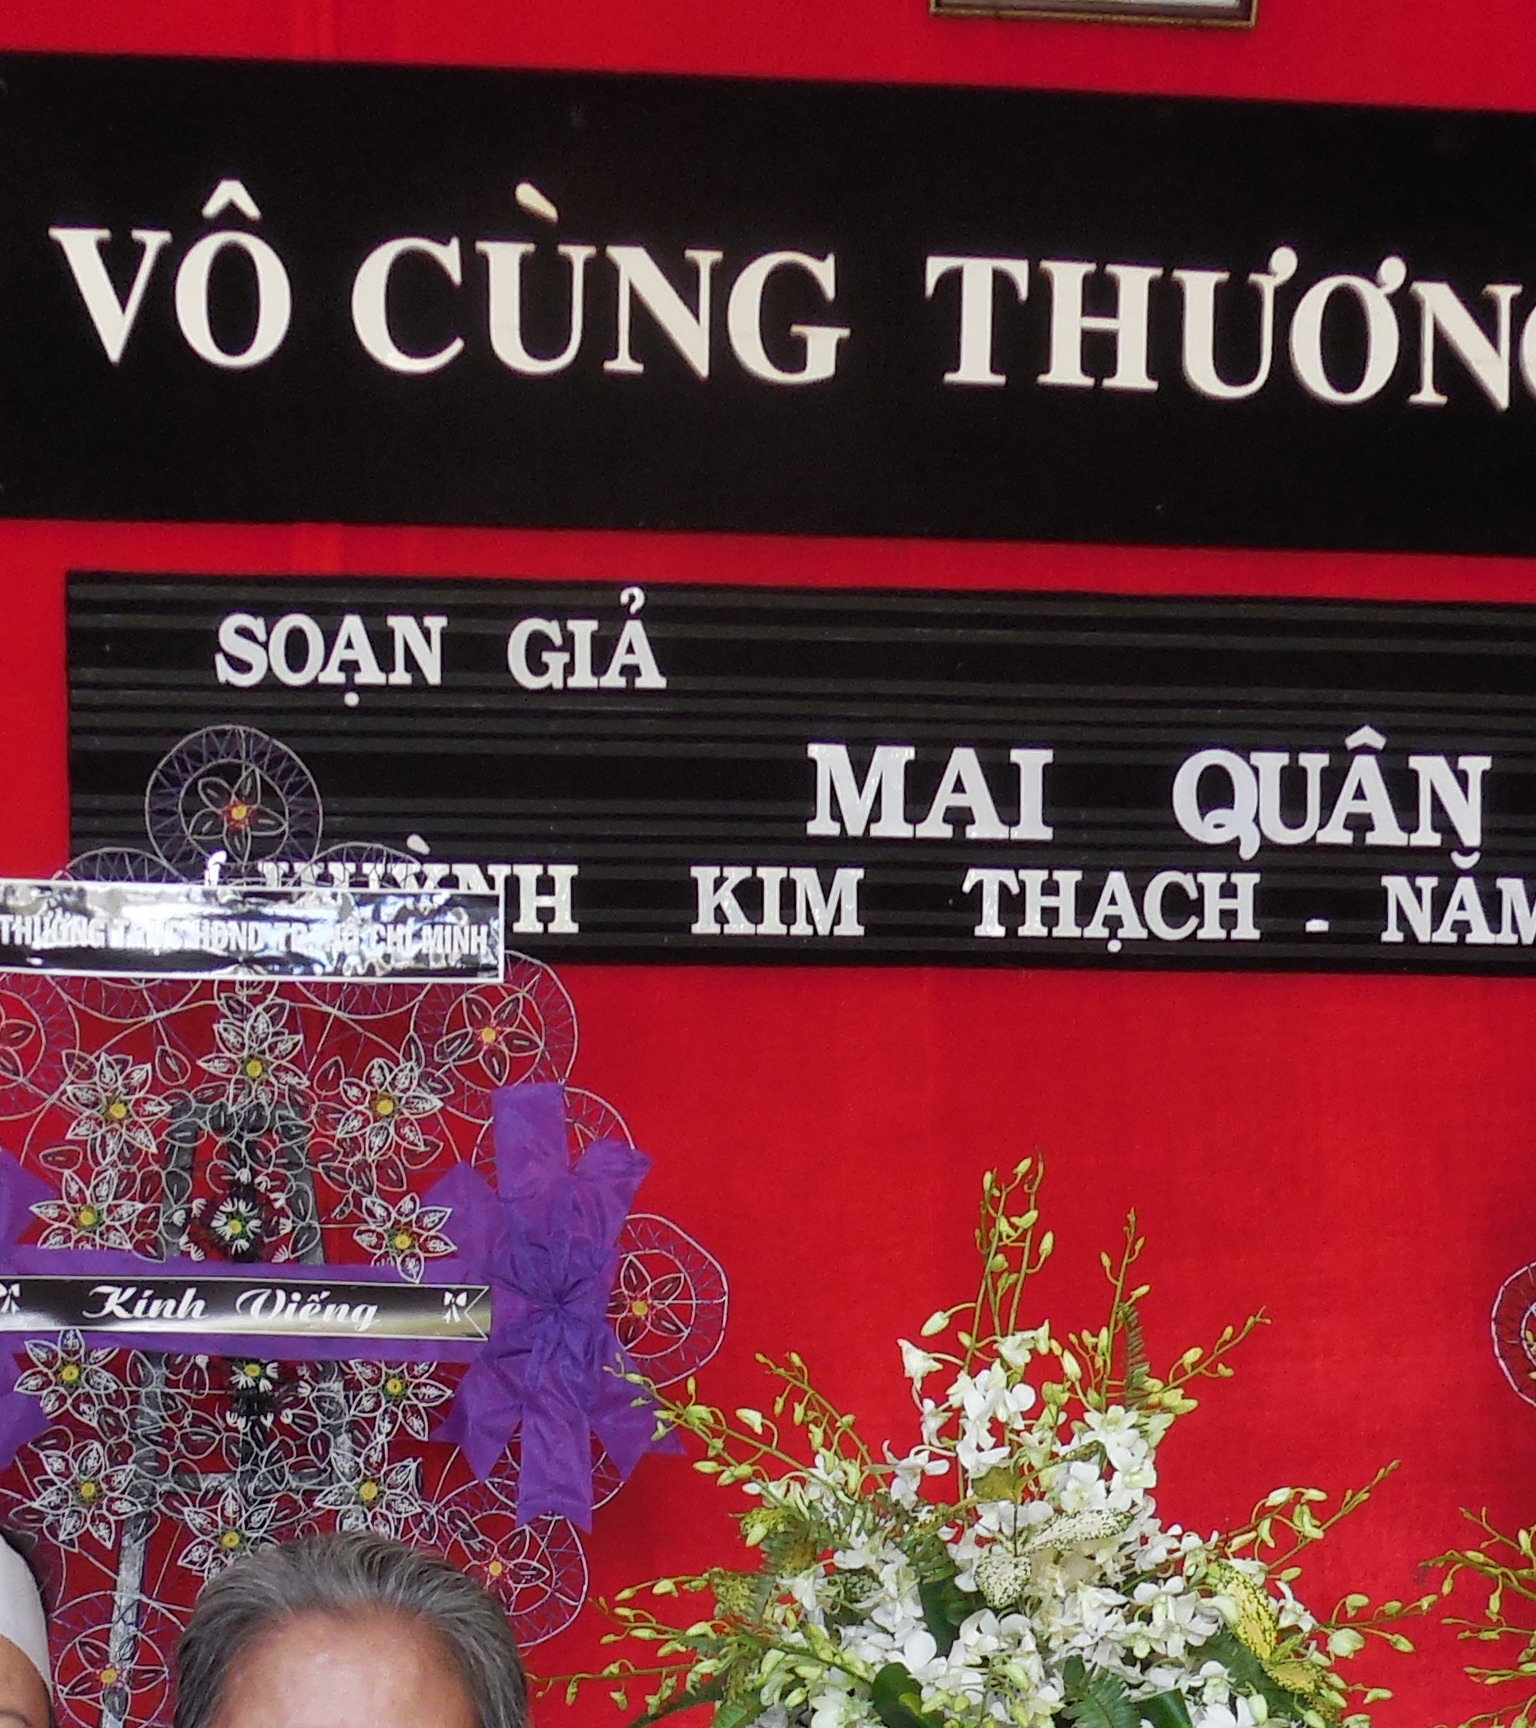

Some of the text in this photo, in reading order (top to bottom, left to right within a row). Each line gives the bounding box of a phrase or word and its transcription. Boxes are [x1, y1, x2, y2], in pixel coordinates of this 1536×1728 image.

[48, 180, 291, 368] VÔ
[352, 183, 850, 385] CÙNG
[215, 587, 667, 707] SOẠN GIẢ
[806, 724, 1492, 861] MAI QUÂN
[421, 923, 488, 954] MINH
[691, 866, 864, 936] KIM
[962, 868, 1261, 953] THẠCH
[82, 1285, 380, 1331] Kính Viếng
